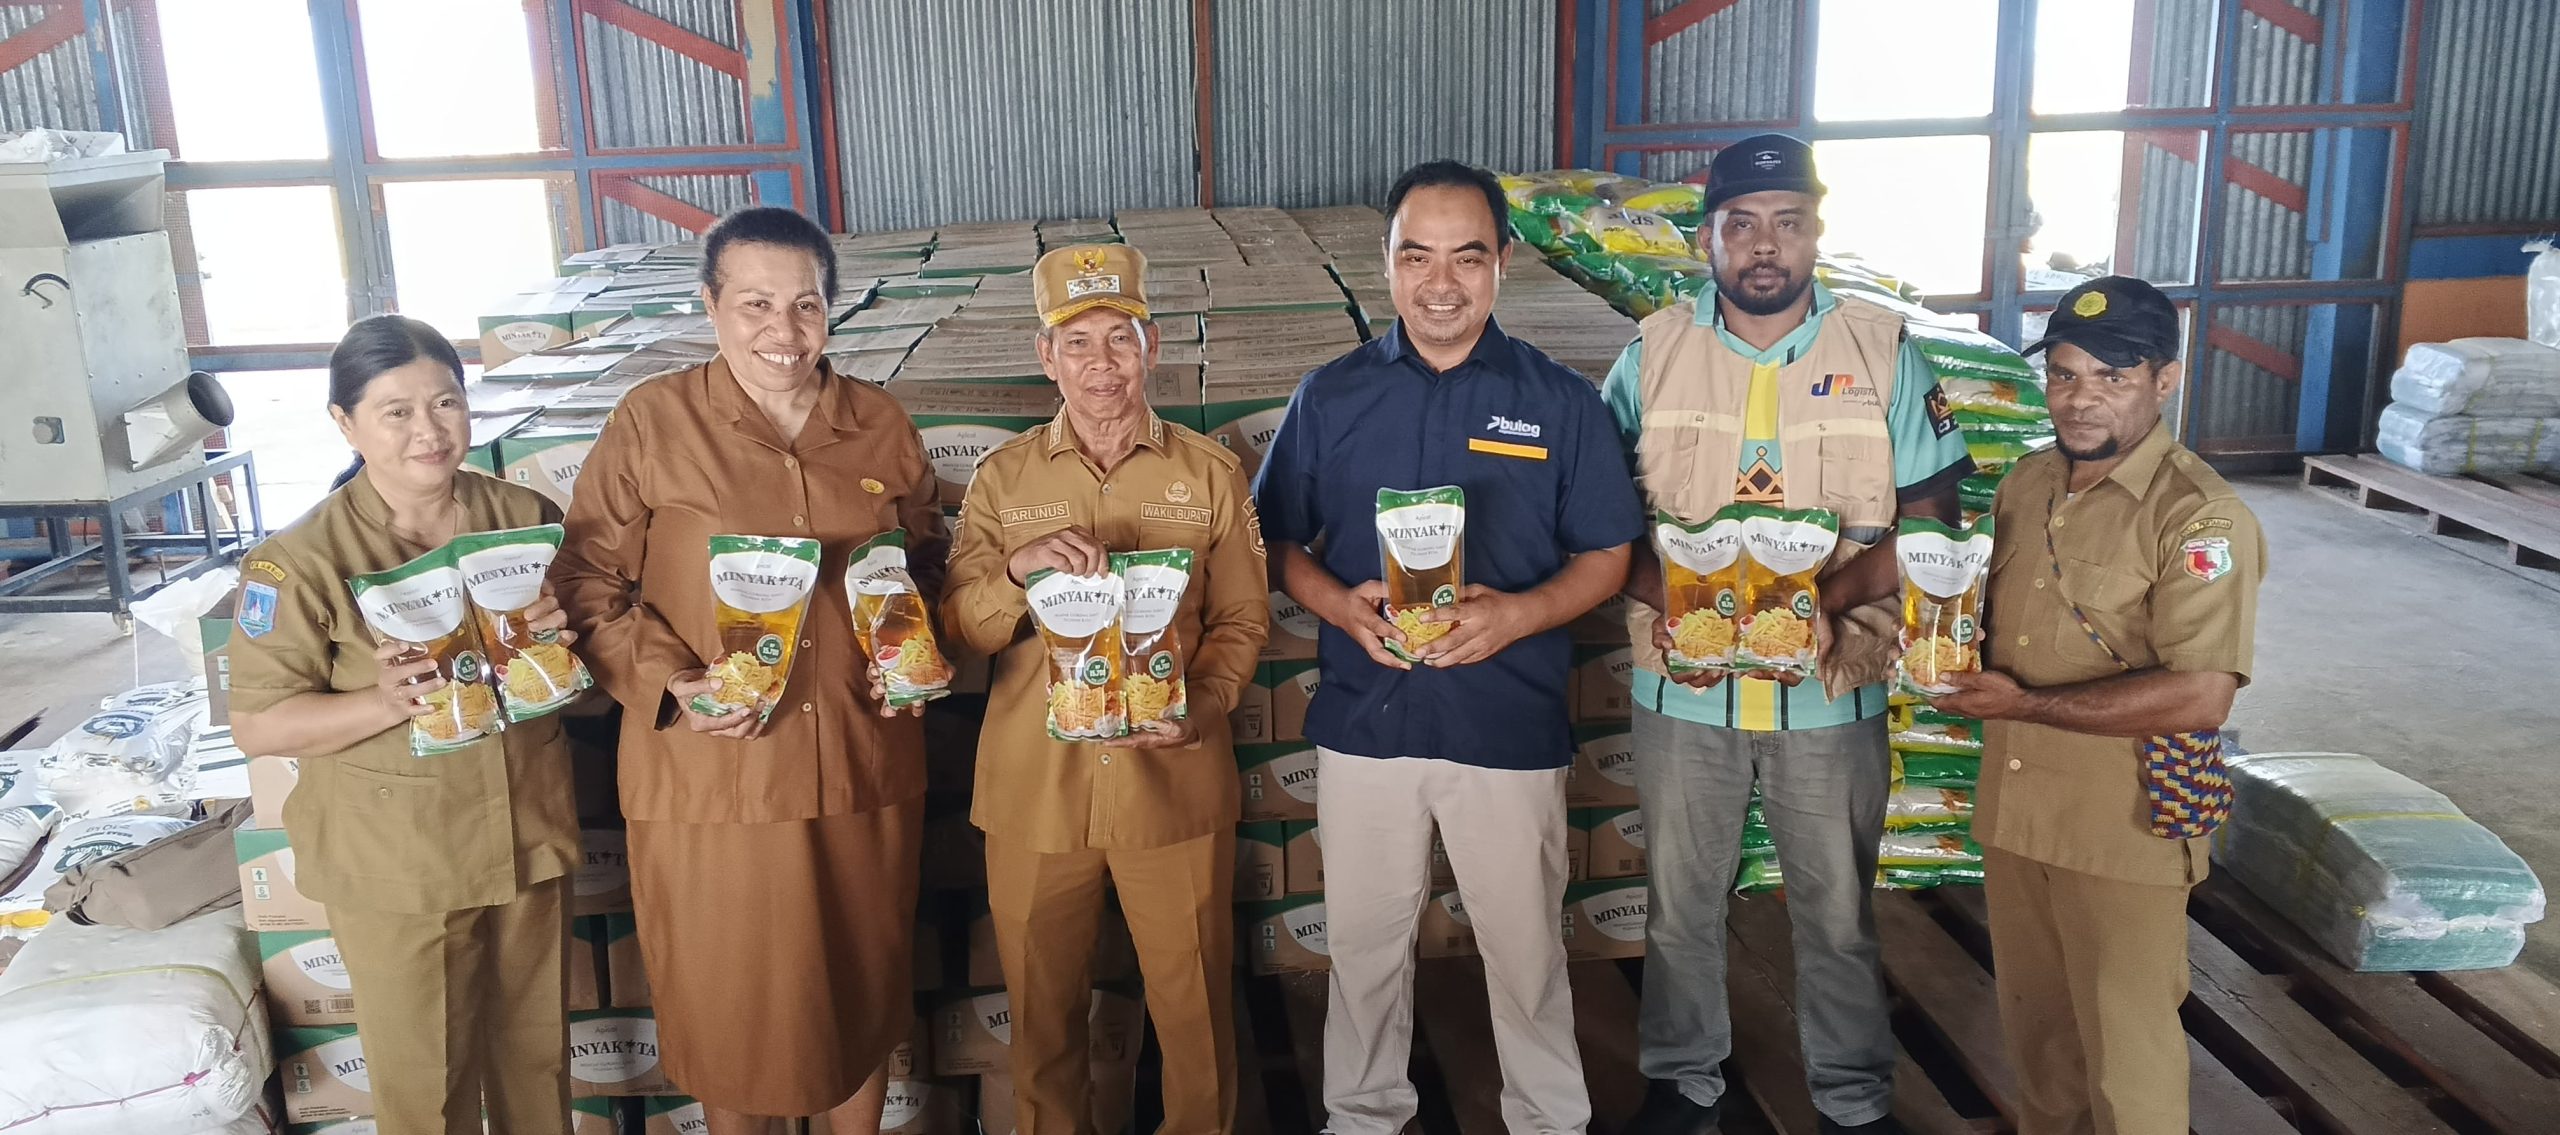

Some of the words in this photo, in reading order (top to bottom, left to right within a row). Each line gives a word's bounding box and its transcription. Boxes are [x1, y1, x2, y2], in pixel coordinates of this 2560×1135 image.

[1499, 416, 1541, 438] bulog
[1144, 505, 1176, 520] WAKIL
[1176, 508, 1210, 524] BUPATI
